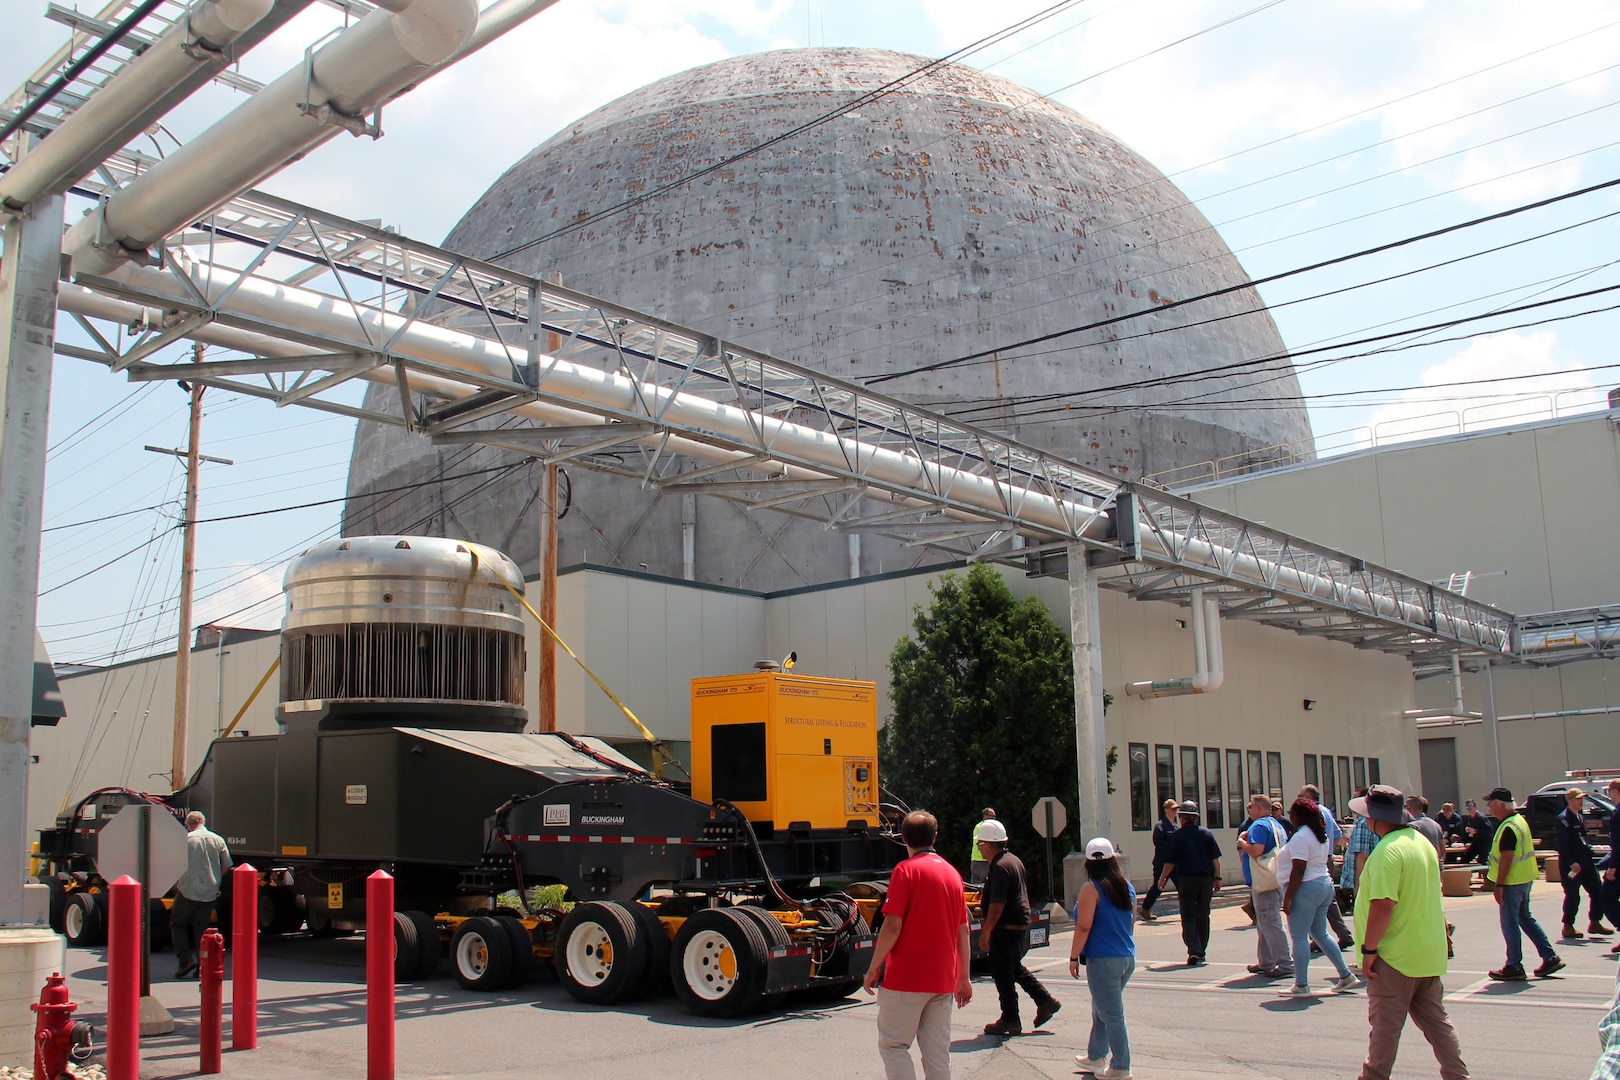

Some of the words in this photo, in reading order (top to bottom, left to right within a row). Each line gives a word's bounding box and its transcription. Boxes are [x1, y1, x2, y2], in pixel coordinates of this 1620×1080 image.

[696, 687, 729, 696] BUCKINGHAM
[779, 687, 811, 696] BUCKINGHAM
[784, 716, 814, 726] STRUCTURAL
[815, 716, 834, 727] LIFTING
[834, 719, 839, 727] &
[839, 719, 867, 729] RELOCATION
[581, 815, 625, 824] BUCKINGHAM
